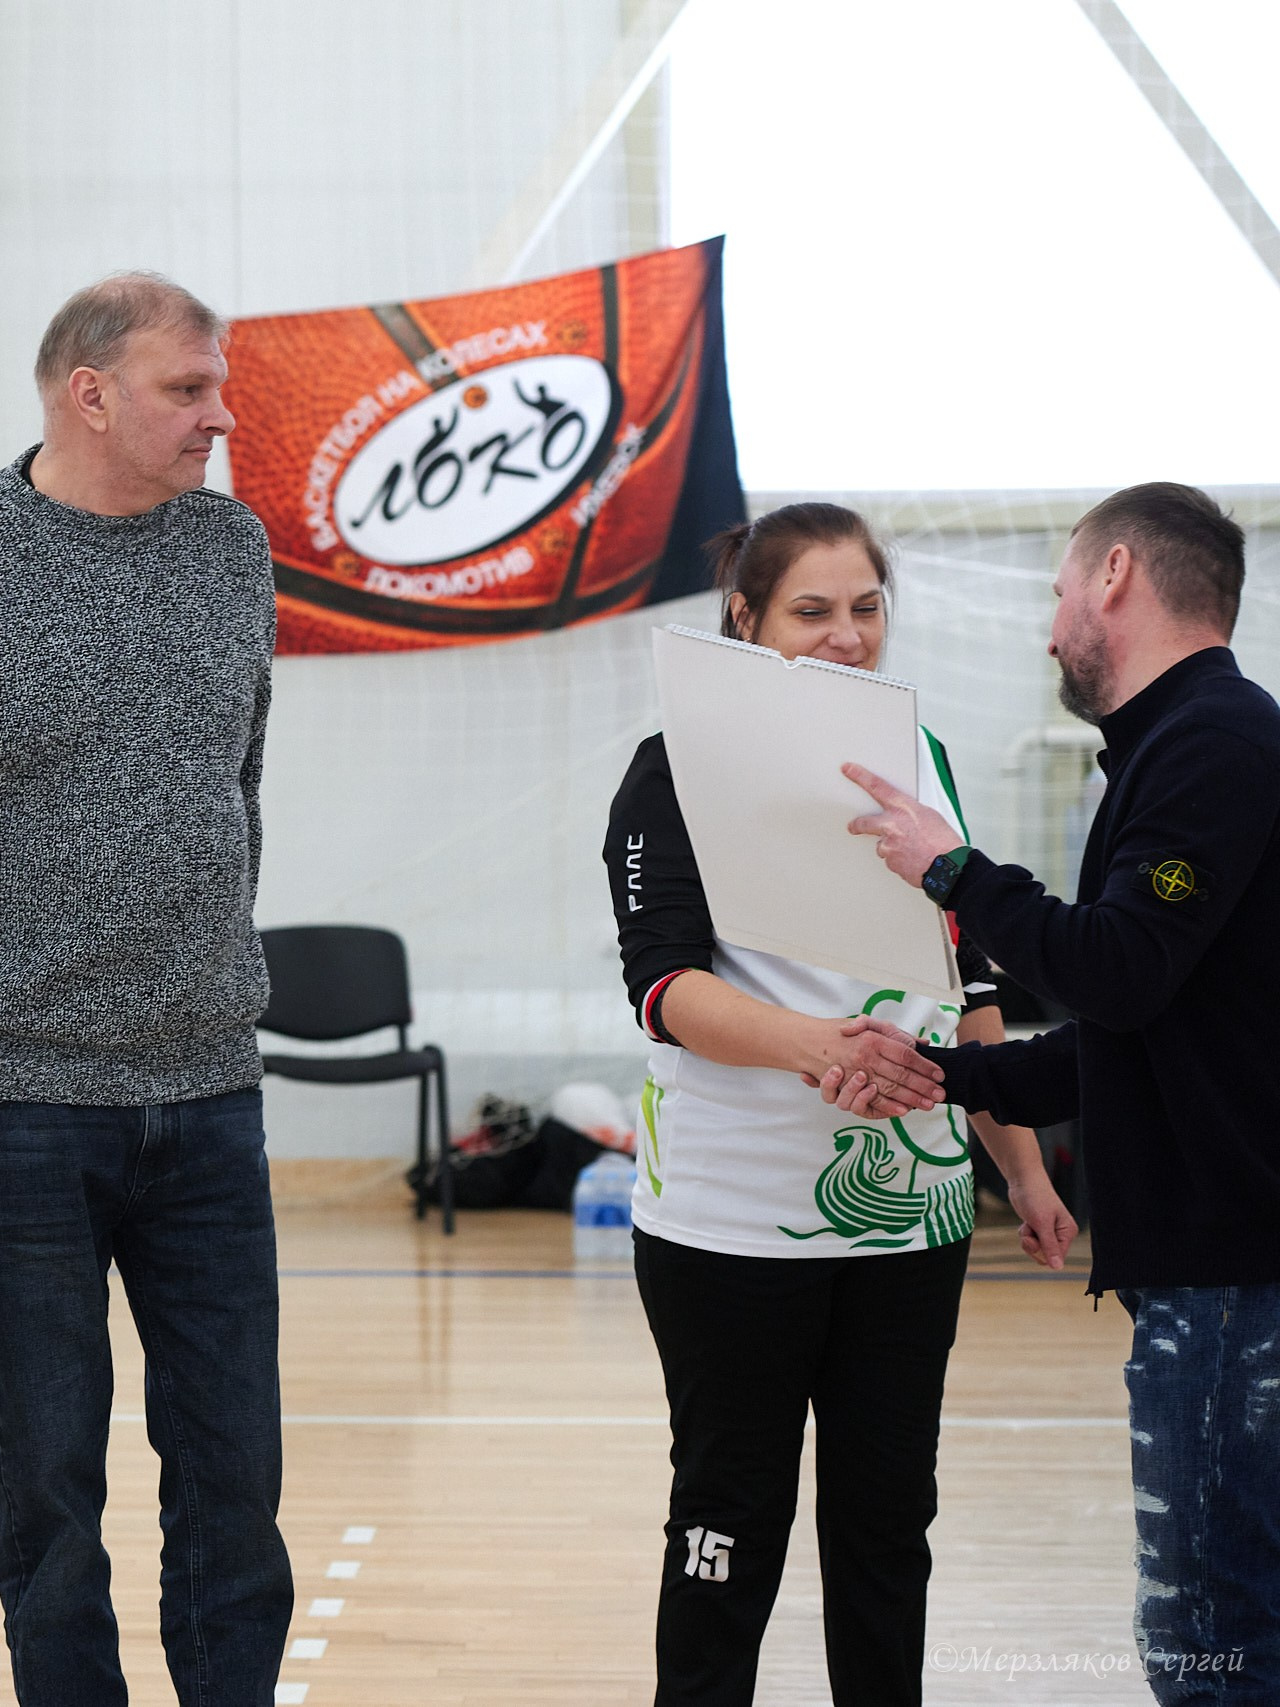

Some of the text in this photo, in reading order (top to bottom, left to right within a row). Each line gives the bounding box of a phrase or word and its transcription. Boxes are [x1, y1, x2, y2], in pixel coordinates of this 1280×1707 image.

[376, 370, 420, 406] НА
[365, 546, 534, 601] ЛОКОМОТИВ
[684, 1525, 735, 1583] 15
